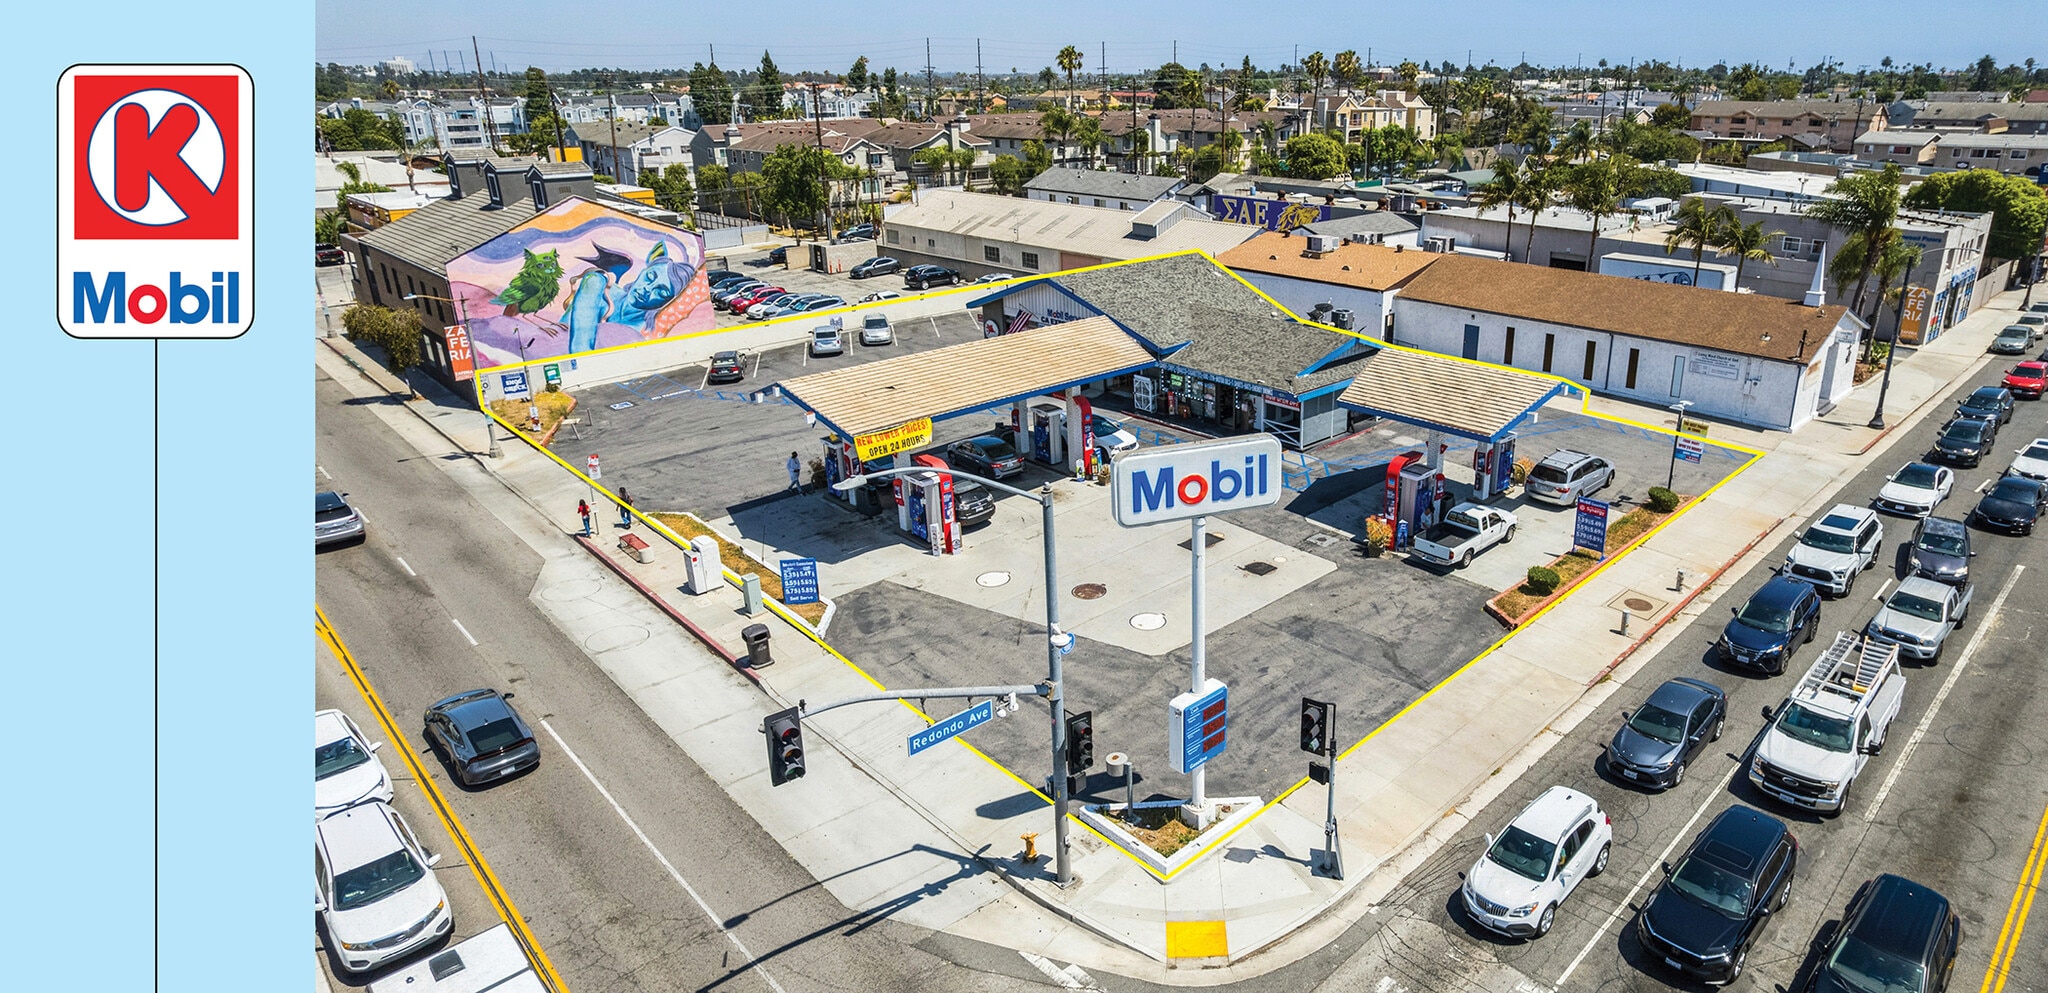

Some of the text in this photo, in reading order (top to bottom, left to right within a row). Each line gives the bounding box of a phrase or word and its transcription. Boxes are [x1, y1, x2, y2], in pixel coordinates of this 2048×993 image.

[1908, 286, 1927, 299] ZA
[1908, 299, 1925, 311] FE
[1047, 308, 1064, 318] Mobil
[446, 325, 467, 338] ZA
[450, 337, 470, 349] FE
[856, 420, 929, 447] NEW LOWER PRICES!
[869, 434, 926, 457] OPEN 24 HOURS
[1132, 453, 1268, 514] Mobil
[1586, 507, 1605, 516] Synergy
[913, 709, 989, 750] Redondo Ave
